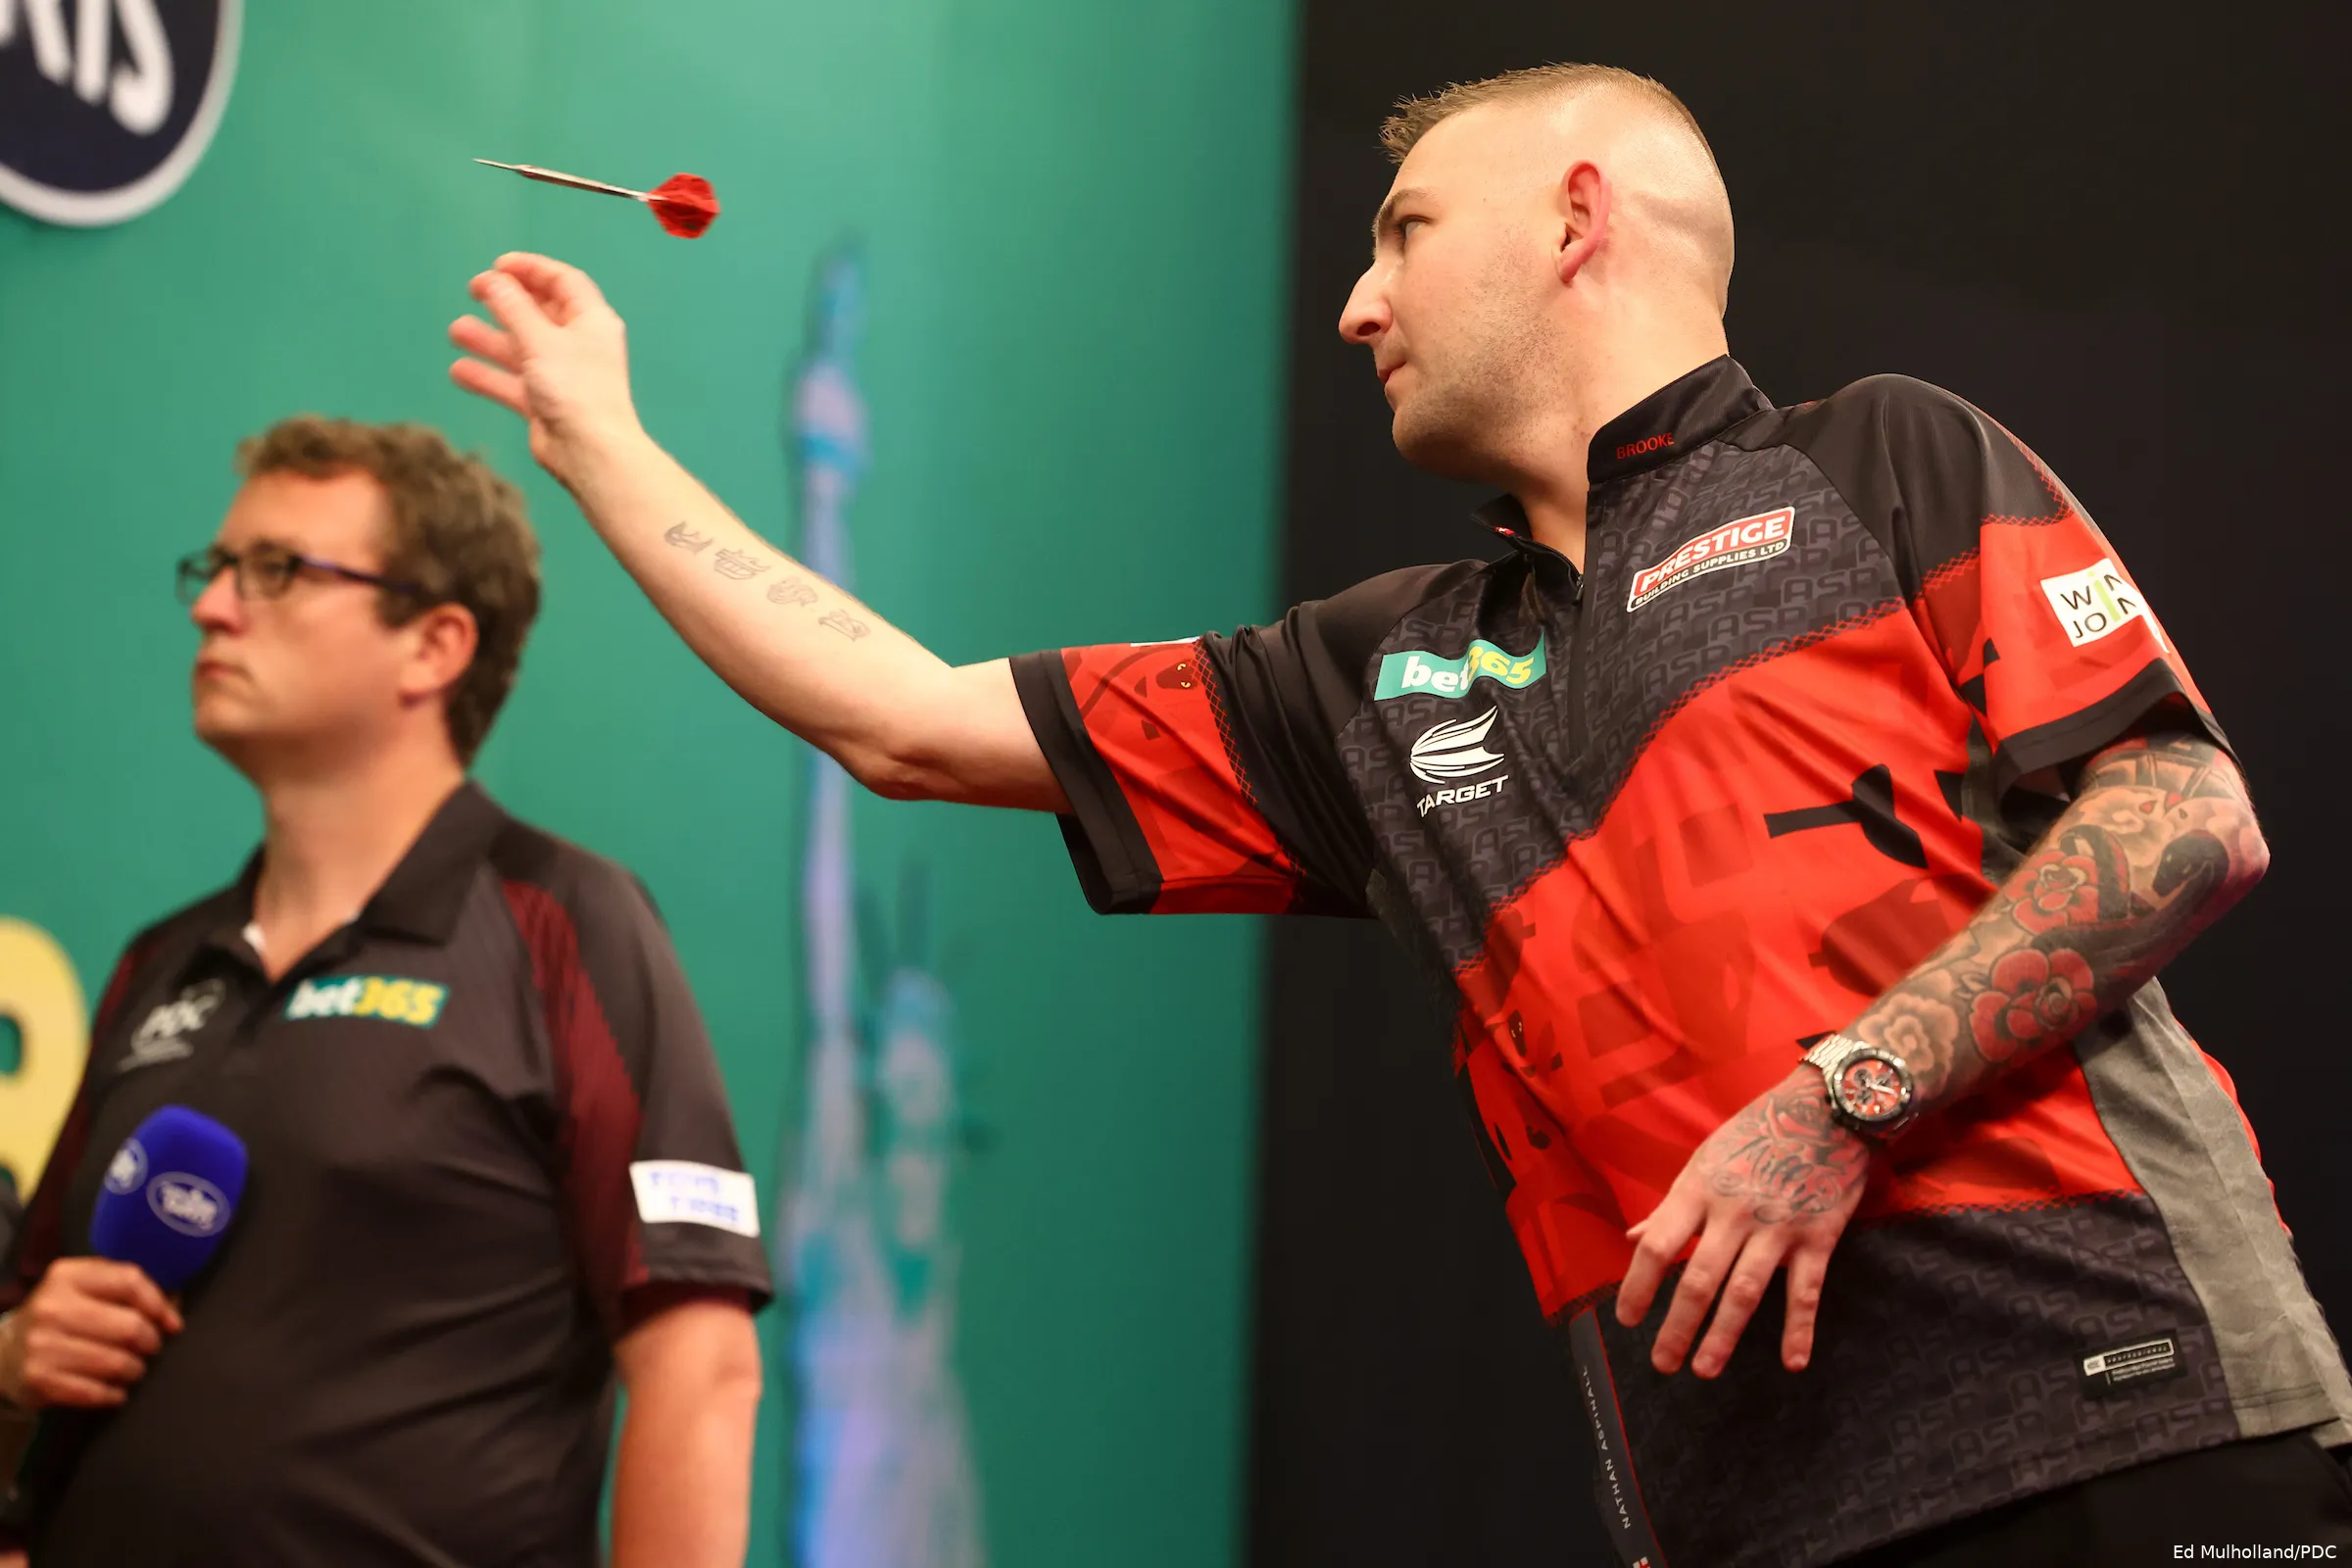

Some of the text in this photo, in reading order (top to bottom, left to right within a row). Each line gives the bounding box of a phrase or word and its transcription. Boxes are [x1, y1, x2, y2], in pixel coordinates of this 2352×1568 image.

[1616, 432, 1675, 460] BROOKE
[1635, 541, 1786, 606] BUILDING SUPPLIES LTD
[1639, 514, 1787, 593] PRESTIGE
[1400, 645, 1535, 693] bet365
[1416, 774, 1509, 818] TARGET
[1604, 1457, 1632, 1530] NATHAN
